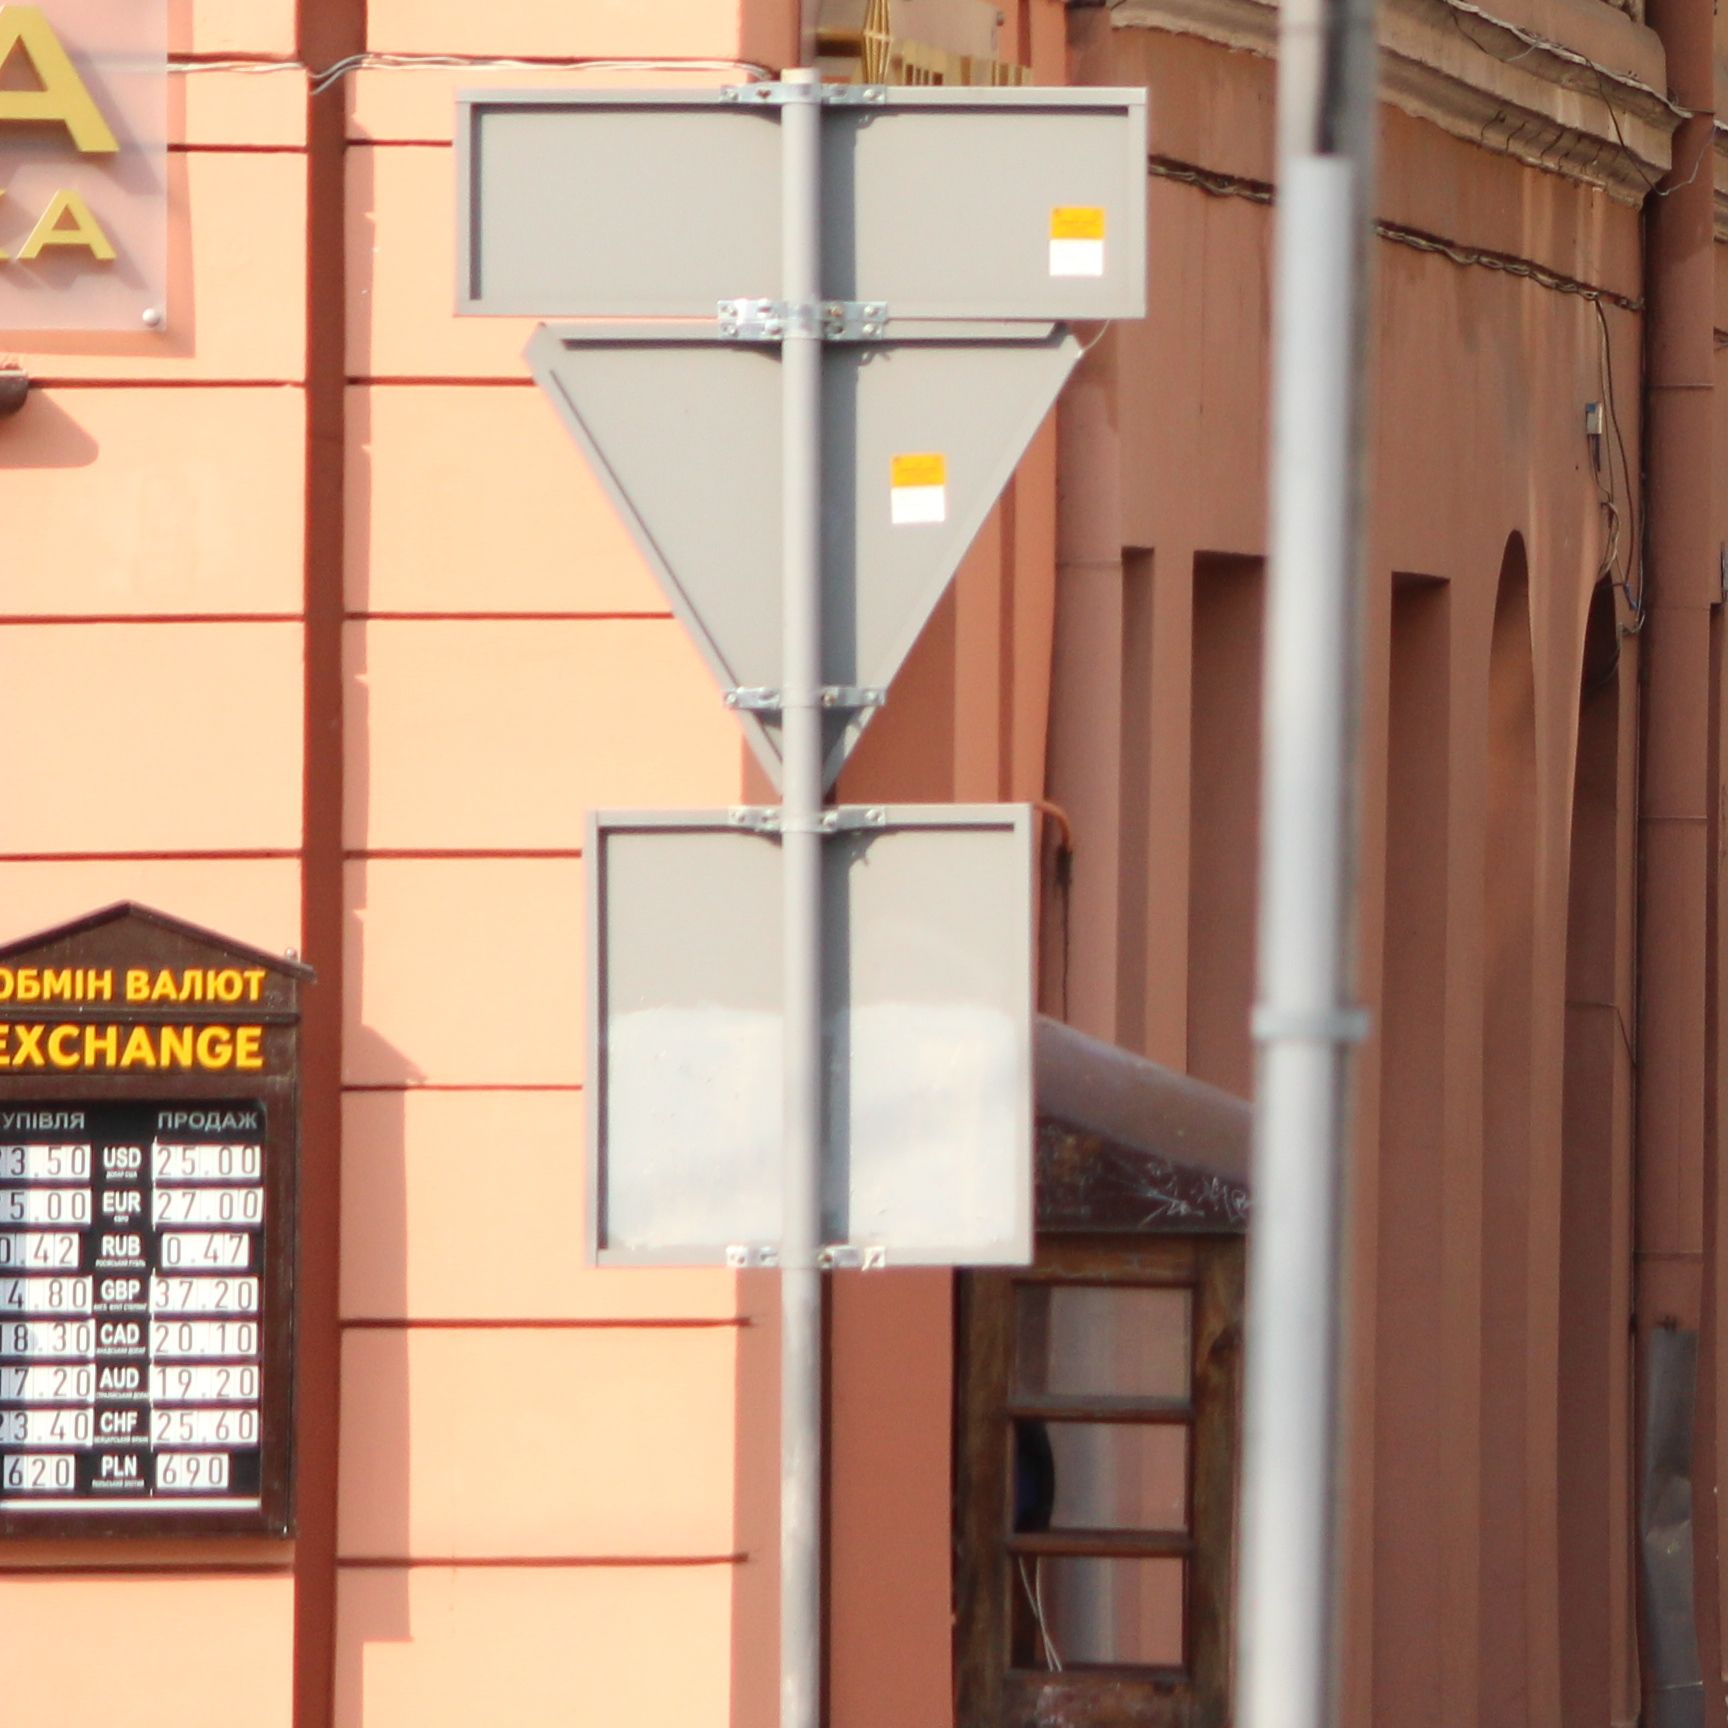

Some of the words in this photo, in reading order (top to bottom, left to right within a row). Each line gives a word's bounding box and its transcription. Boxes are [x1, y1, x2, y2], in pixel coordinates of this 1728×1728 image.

[126, 968, 266, 1002] ВАЛЮТ
[157, 1112, 258, 1132] ПРОДАЖ
[0, 1146, 86, 1177] 3.50
[103, 1146, 142, 1168] USD
[157, 1145, 257, 1177] 25.00
[102, 1190, 141, 1213] EUR
[158, 1190, 259, 1222] 27.00
[102, 1233, 141, 1257] RUB
[166, 1233, 244, 1266] 0.47
[101, 1278, 141, 1301] GBP
[155, 1278, 253, 1311] 37.20
[100, 1322, 140, 1345] CAD
[155, 1323, 253, 1355] 20.10
[99, 1367, 139, 1390] AUD
[157, 1367, 255, 1399] 19.20
[100, 1410, 138, 1434] CHF
[157, 1411, 254, 1443] 25.60
[8, 1455, 70, 1487] 620
[101, 1454, 137, 1478] PLN
[162, 1454, 224, 1487] 690
